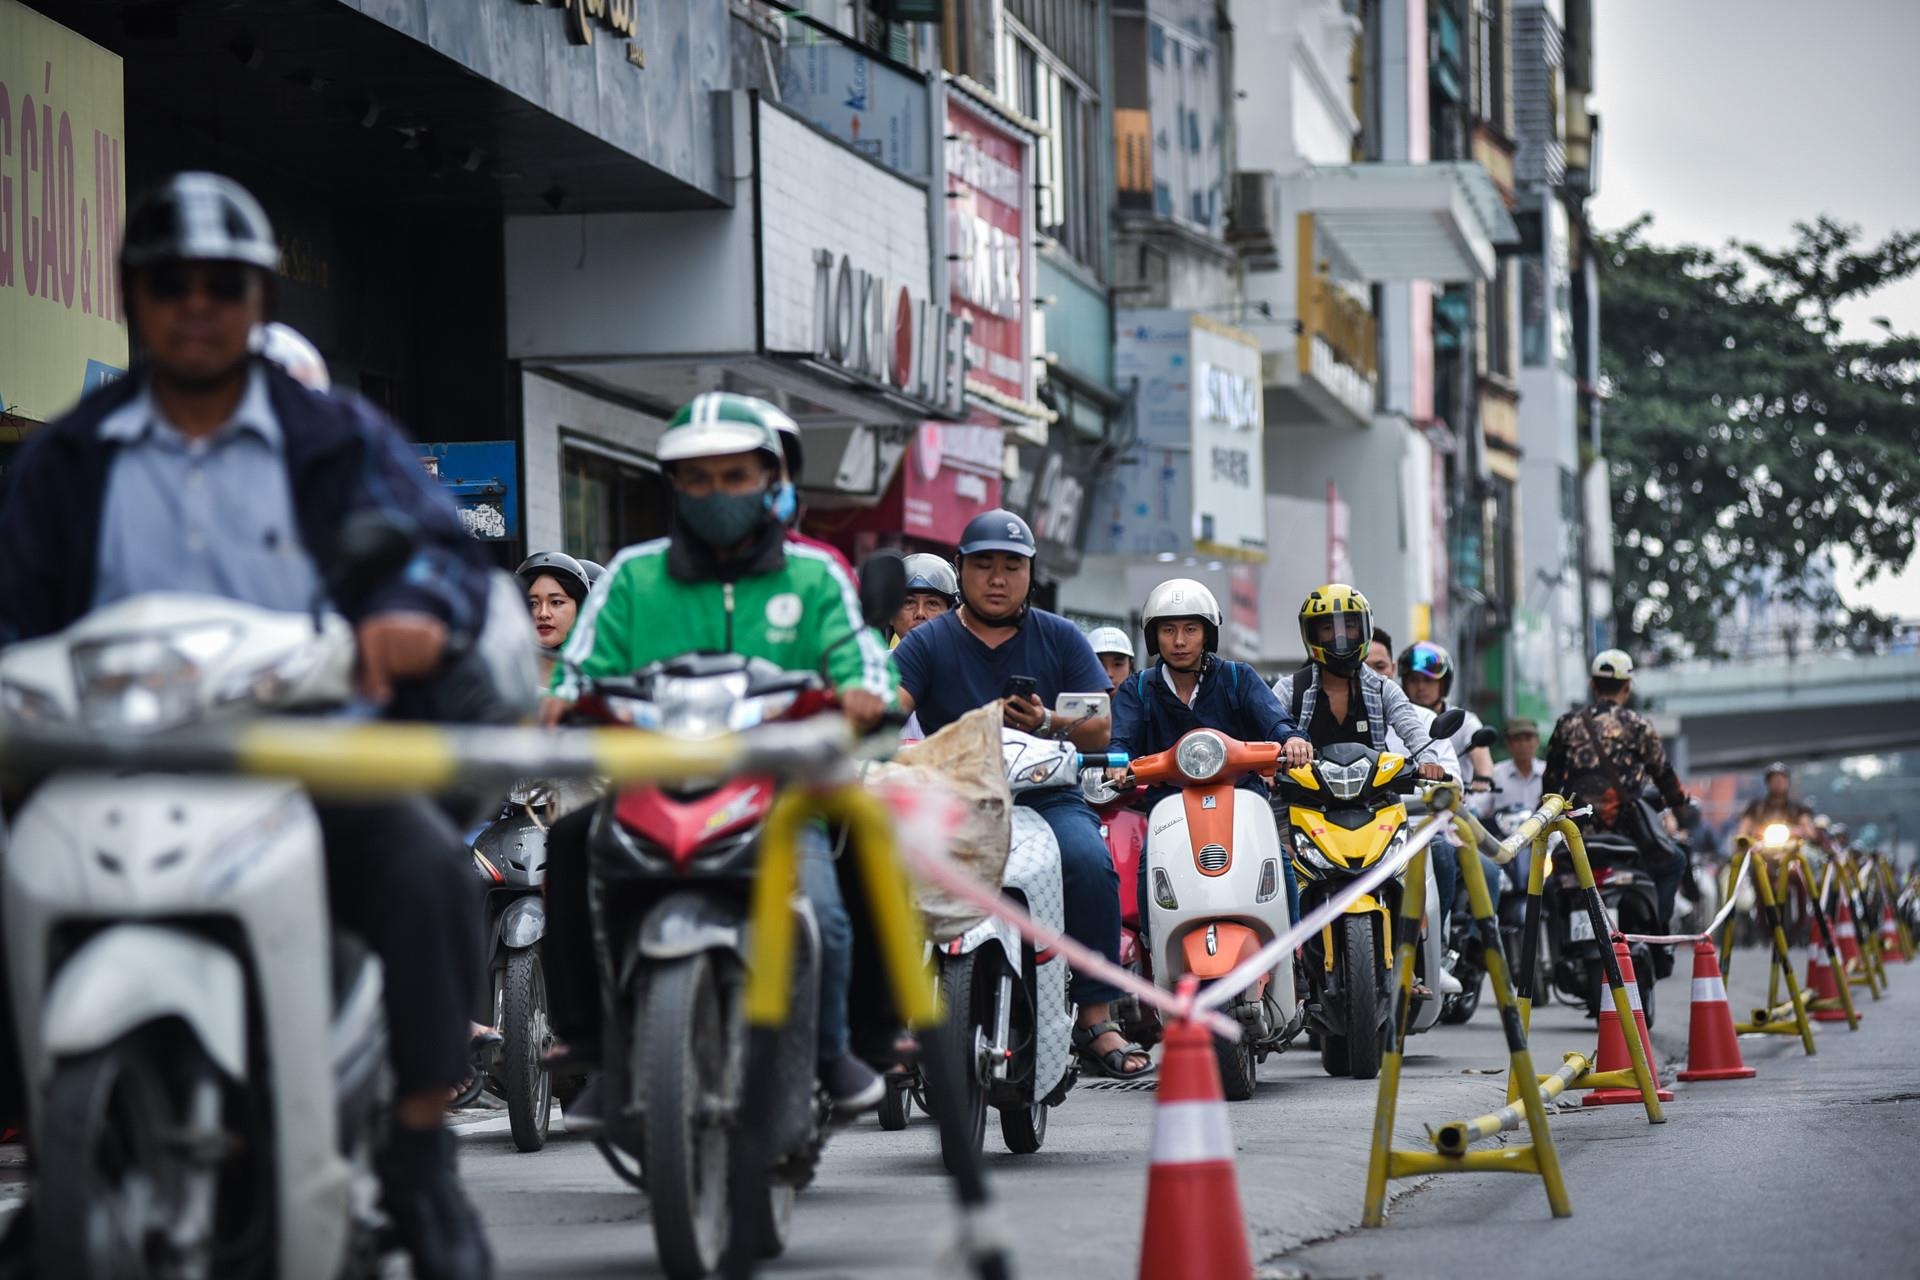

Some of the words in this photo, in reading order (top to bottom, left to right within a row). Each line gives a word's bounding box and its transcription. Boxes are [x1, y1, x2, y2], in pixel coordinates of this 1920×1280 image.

[20, 60, 76, 310] CÁO
[80, 197, 93, 315] &
[94, 127, 122, 325] IN
